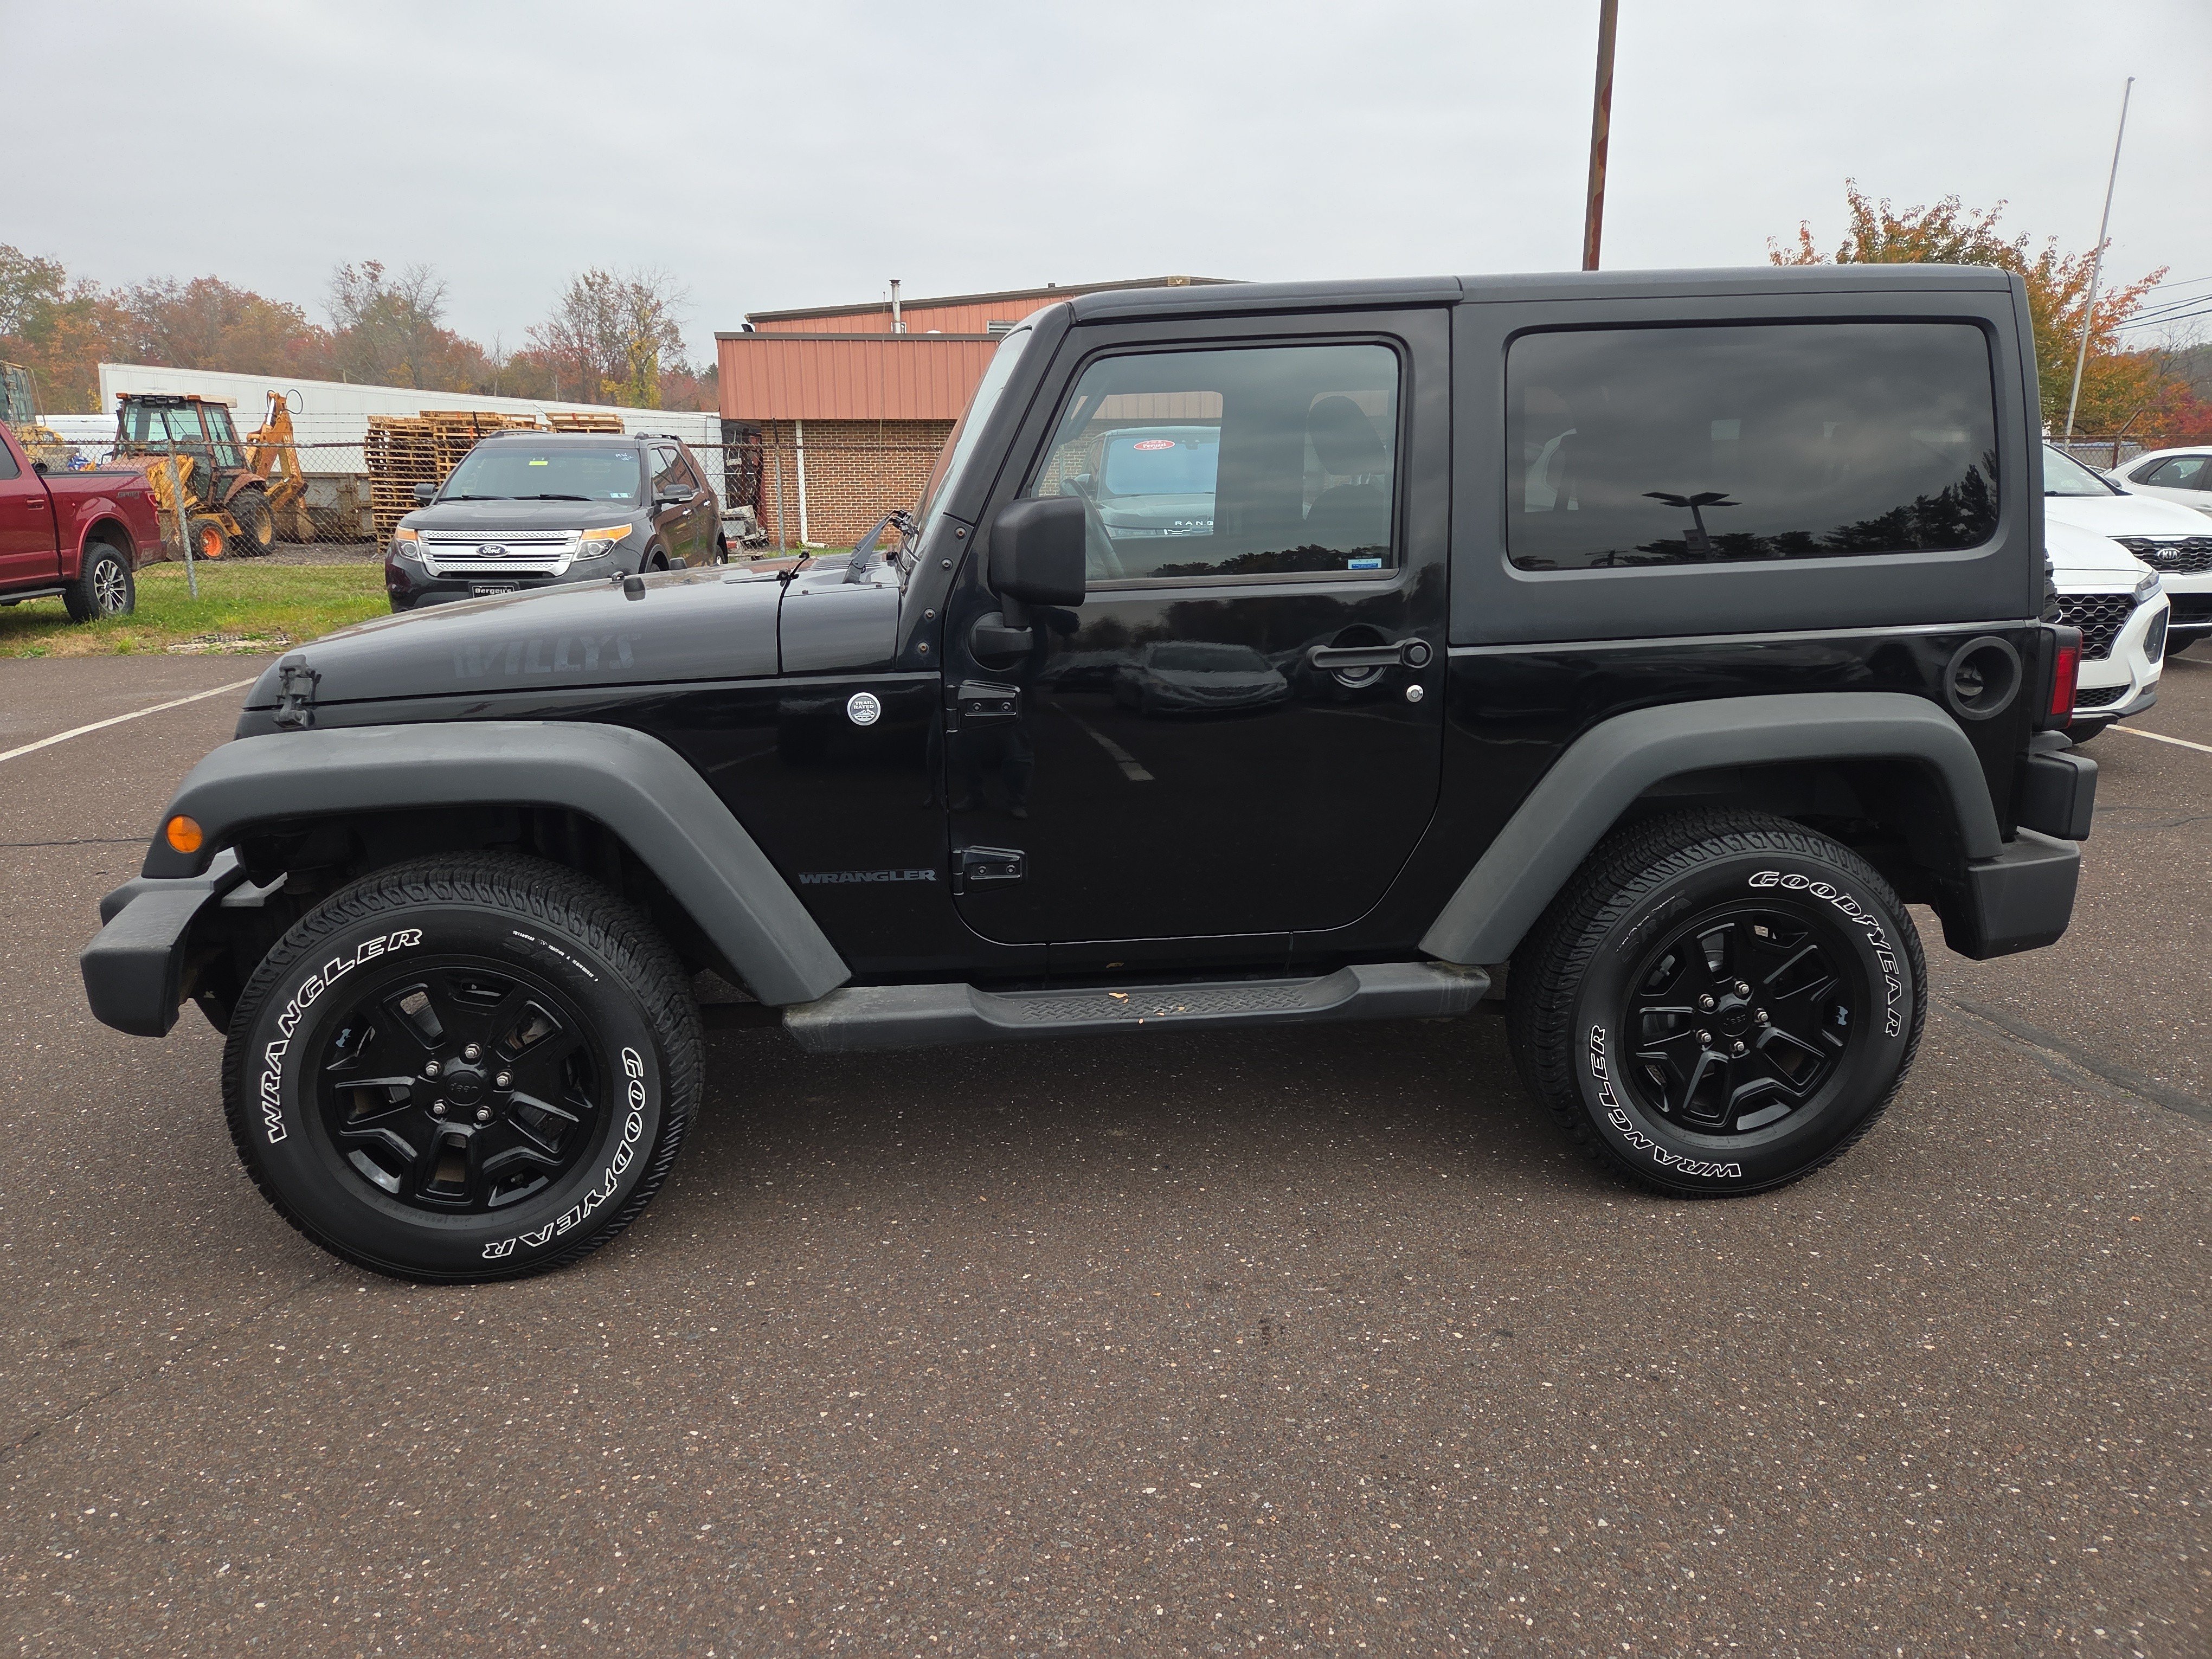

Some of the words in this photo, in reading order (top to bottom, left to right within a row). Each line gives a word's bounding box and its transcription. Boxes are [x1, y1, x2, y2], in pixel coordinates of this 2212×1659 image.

[2162, 551, 2177, 559] KIA
[453, 633, 635, 678] WILLYS
[799, 870, 937, 884] WRANGLER
[1748, 870, 1902, 1038] GOODYEAR
[260, 928, 423, 1144] WRANGLER
[1590, 1024, 1742, 1178] WRANGLER
[481, 1047, 646, 1259] GOODYEAR
